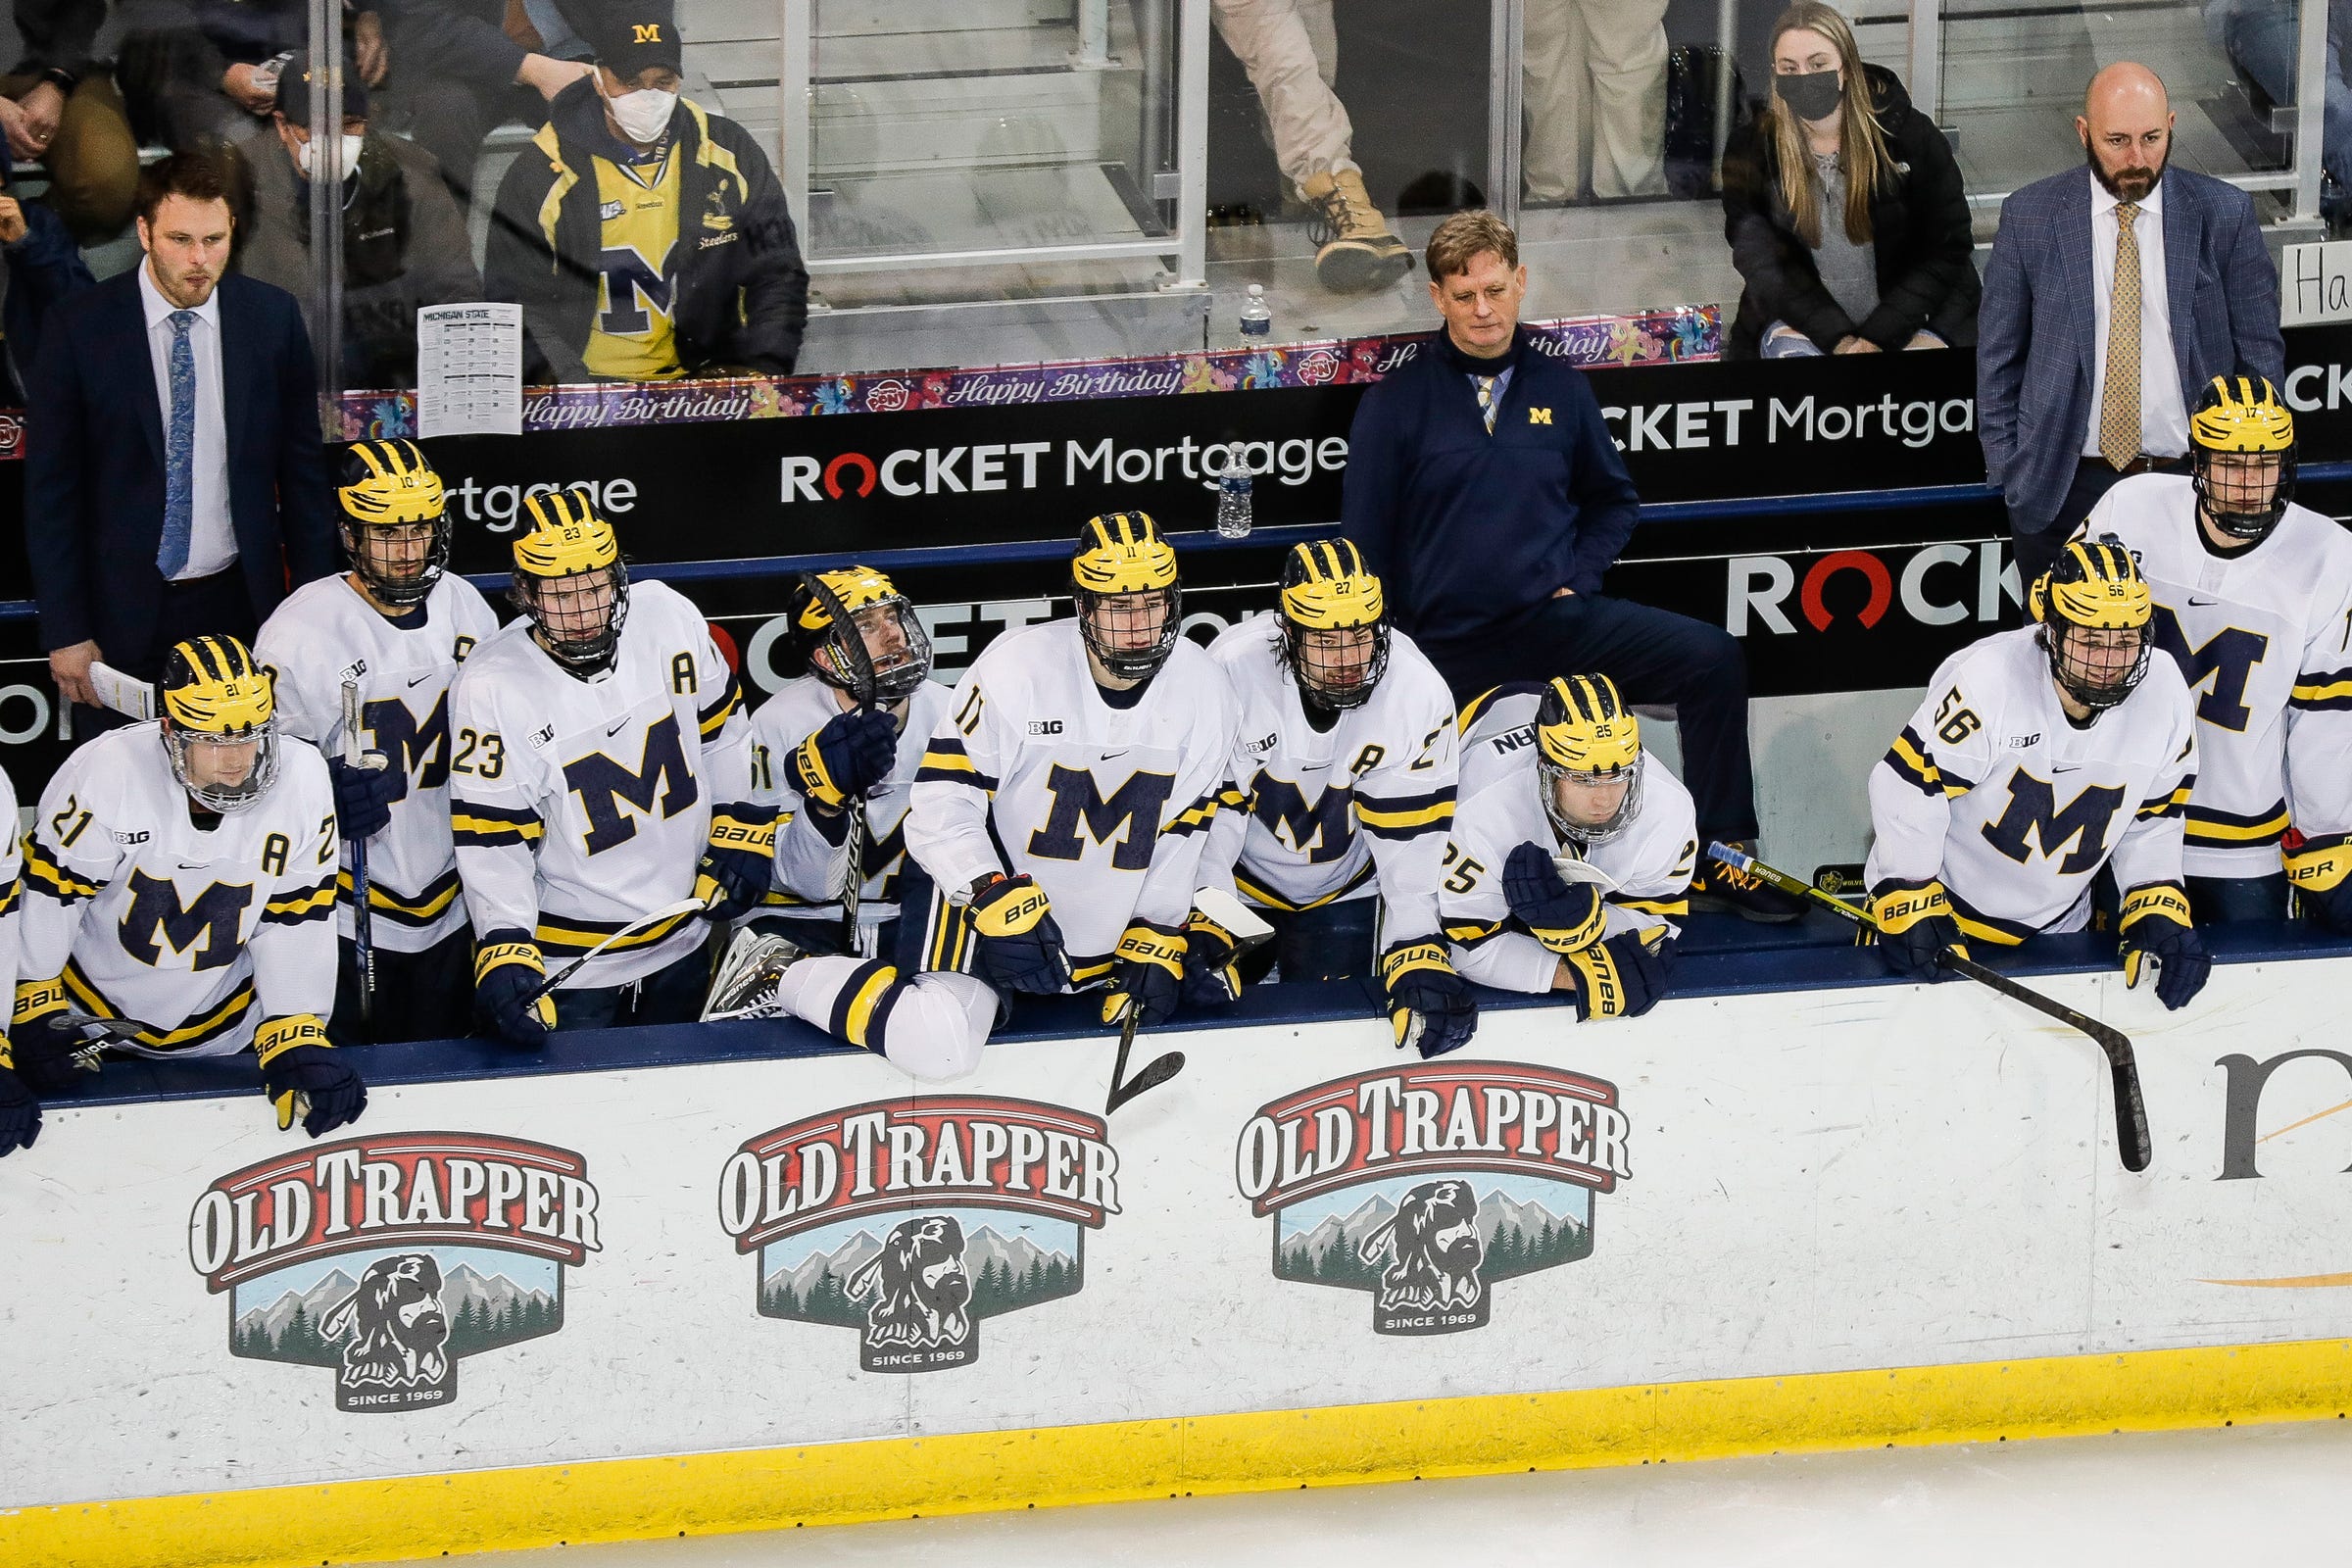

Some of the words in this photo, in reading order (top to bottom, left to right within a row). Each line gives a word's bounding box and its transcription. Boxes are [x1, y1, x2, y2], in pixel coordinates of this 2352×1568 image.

[632, 24, 662, 43] M
[698, 231, 738, 250] Steelers
[423, 311, 464, 322] MICHIGAN
[466, 309, 490, 319] STATE
[948, 374, 1043, 405] Happy
[1049, 368, 1182, 396] Birthday
[612, 394, 749, 422] Birthday
[1529, 407, 1552, 424] M
[1768, 393, 1974, 449] Mortga
[2245, 408, 2257, 417] 17
[401, 476, 414, 488] 10
[780, 441, 1051, 503] ROCKET
[1066, 435, 1349, 492] Mortgage
[563, 526, 580, 540] 23
[1126, 546, 1137, 558] 11
[1335, 582, 1350, 595] 27
[2108, 585, 2125, 597] 56
[672, 651, 698, 696] A
[2151, 602, 2271, 734] M
[224, 684, 240, 697] 21
[955, 683, 986, 736] 11
[1596, 724, 1612, 738] 25
[1934, 684, 1982, 745] 56
[360, 686, 451, 804] M
[452, 728, 506, 780] 23
[1349, 744, 1385, 775] A
[562, 710, 700, 858] M
[52, 793, 93, 849] 21
[1027, 760, 1176, 872] M
[1250, 767, 1355, 865] M
[1981, 764, 2127, 875] M
[262, 832, 289, 877] A
[118, 866, 256, 972] M
[1237, 1105, 1355, 1201] OLD
[1358, 1076, 1634, 1181] TRAPPER
[718, 1139, 828, 1237] OLD
[842, 1109, 1124, 1216] TRAPPER
[188, 1178, 314, 1276] OLD
[315, 1148, 605, 1254] TRAPPER
[1384, 1315, 1435, 1329] SINCE
[1440, 1312, 1478, 1326] 1969
[871, 1353, 923, 1367] SINCE
[928, 1349, 965, 1363] 1969
[347, 1393, 401, 1407] SINCE
[405, 1390, 444, 1403] 1969
